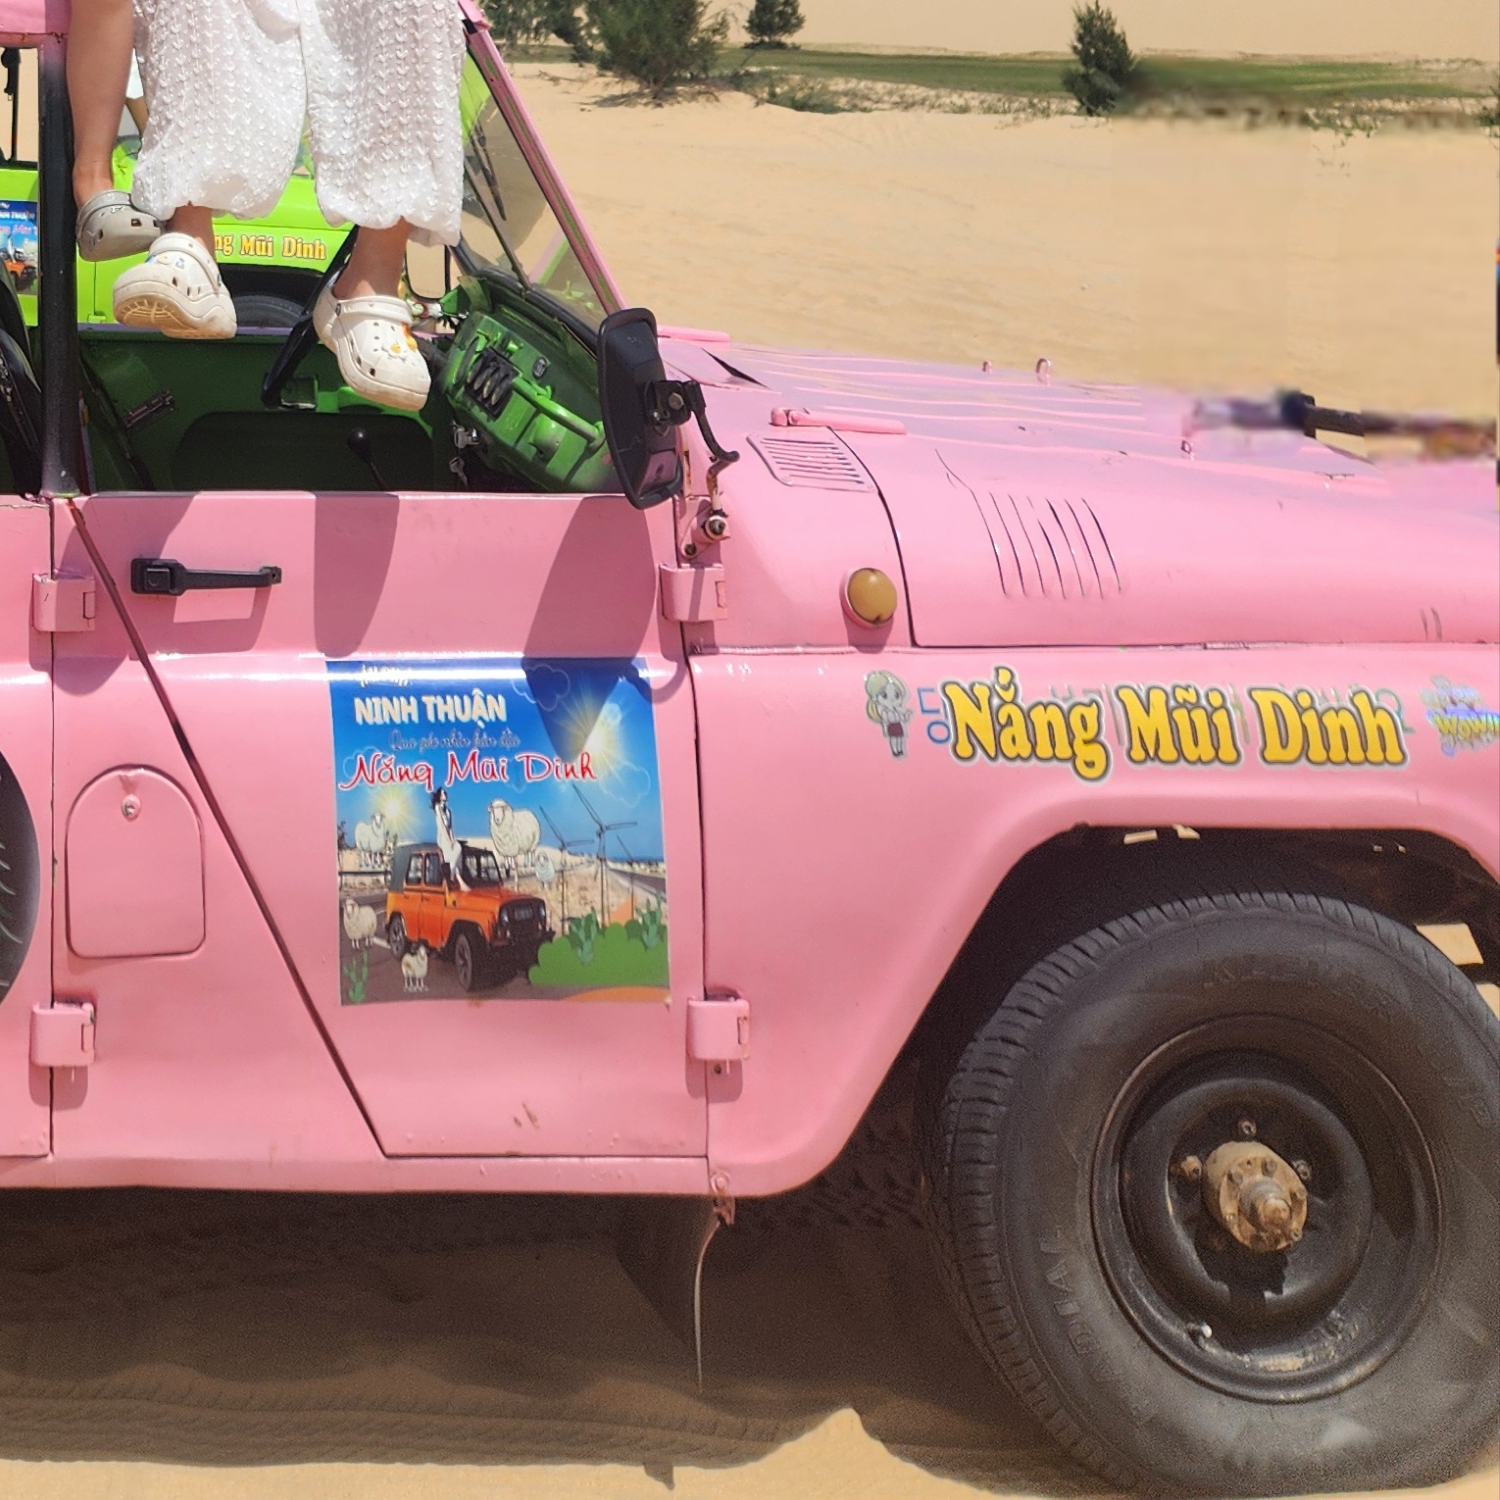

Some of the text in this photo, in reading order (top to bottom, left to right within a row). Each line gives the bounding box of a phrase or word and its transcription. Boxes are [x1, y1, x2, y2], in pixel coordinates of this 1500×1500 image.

[214, 234, 326, 260] ng Mũi Dinh
[354, 687, 507, 728] NINH THUẬN
[942, 666, 1108, 781] Nắng
[1114, 683, 1241, 765] Mũi
[1248, 686, 1407, 766] Dinh
[339, 752, 433, 792] Nắng
[516, 751, 598, 782] Dinh
